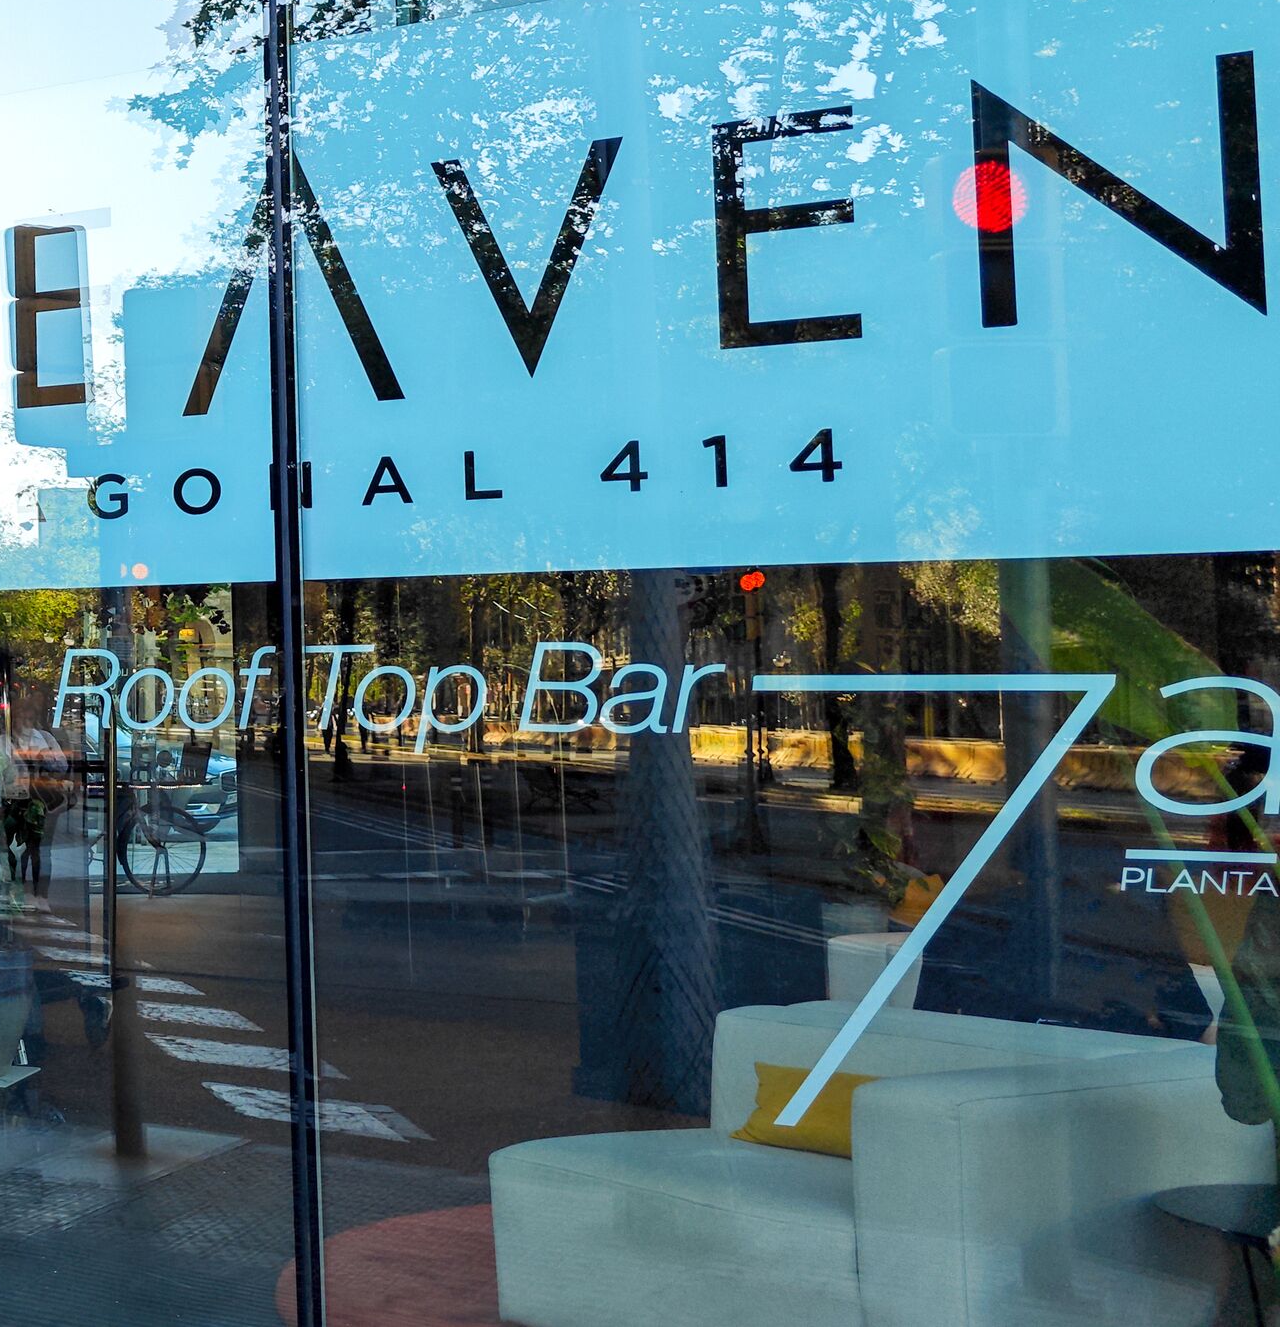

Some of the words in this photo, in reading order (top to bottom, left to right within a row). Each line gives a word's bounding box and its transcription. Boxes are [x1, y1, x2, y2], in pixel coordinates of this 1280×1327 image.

[600, 428, 843, 493] 414
[51, 645, 277, 730] Roof
[303, 643, 488, 755] Top
[519, 641, 727, 735] Bar
[1120, 866, 1279, 897] PLANTA
